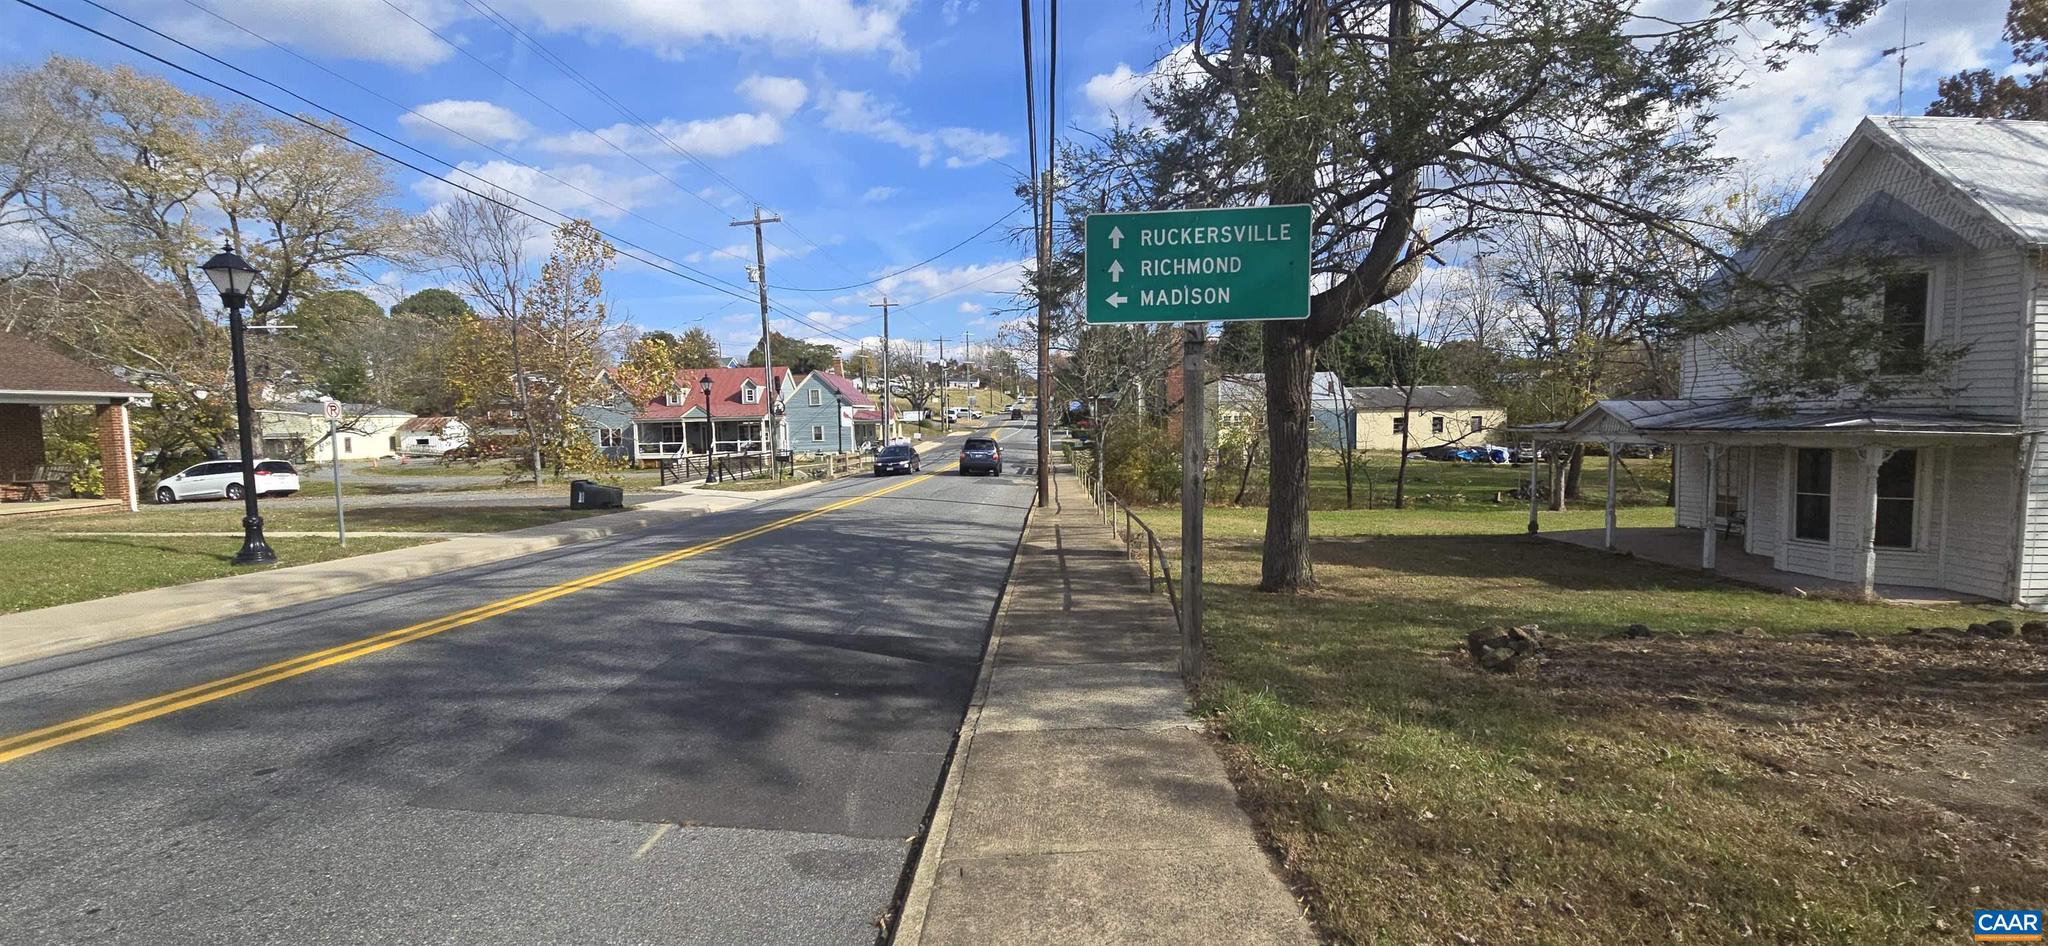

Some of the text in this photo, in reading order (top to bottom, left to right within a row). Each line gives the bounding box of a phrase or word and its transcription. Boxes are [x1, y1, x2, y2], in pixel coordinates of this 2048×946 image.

[1141, 224, 1291, 246] RUCKERSVILLE
[1141, 257, 1241, 276] RICHMOND
[1140, 287, 1230, 306] MADISON
